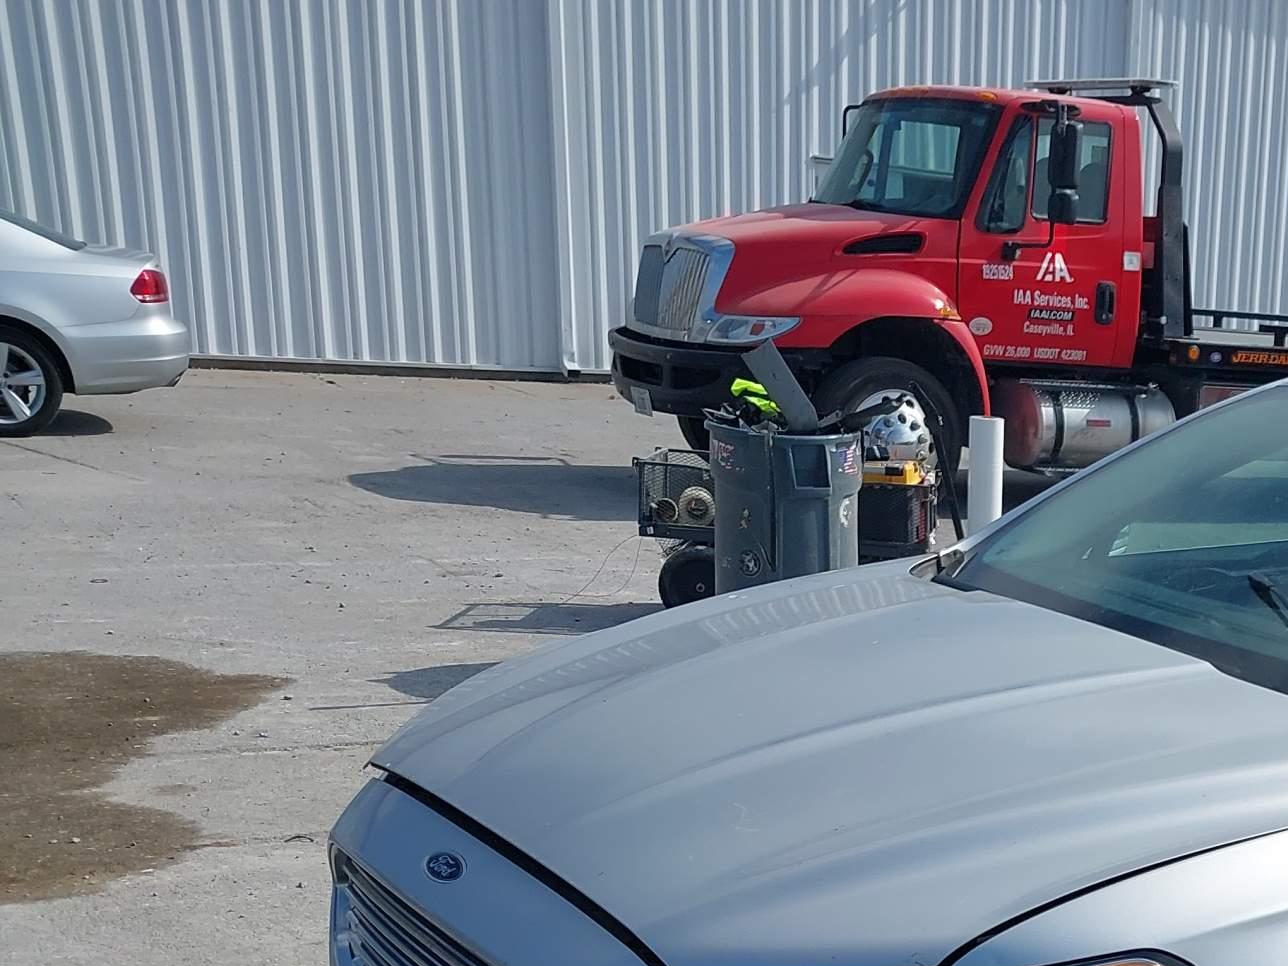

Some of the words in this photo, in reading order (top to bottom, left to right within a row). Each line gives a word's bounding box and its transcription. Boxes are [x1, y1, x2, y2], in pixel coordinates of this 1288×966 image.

[1013, 289, 1031, 305] IAA
[1034, 290, 1073, 309] Services,
[1074, 293, 1089, 309] Inc.
[1023, 320, 1065, 336] Caseyville,
[1066, 325, 1075, 336] IL
[983, 344, 1006, 356] GVW
[1034, 347, 1060, 360] USDOT
